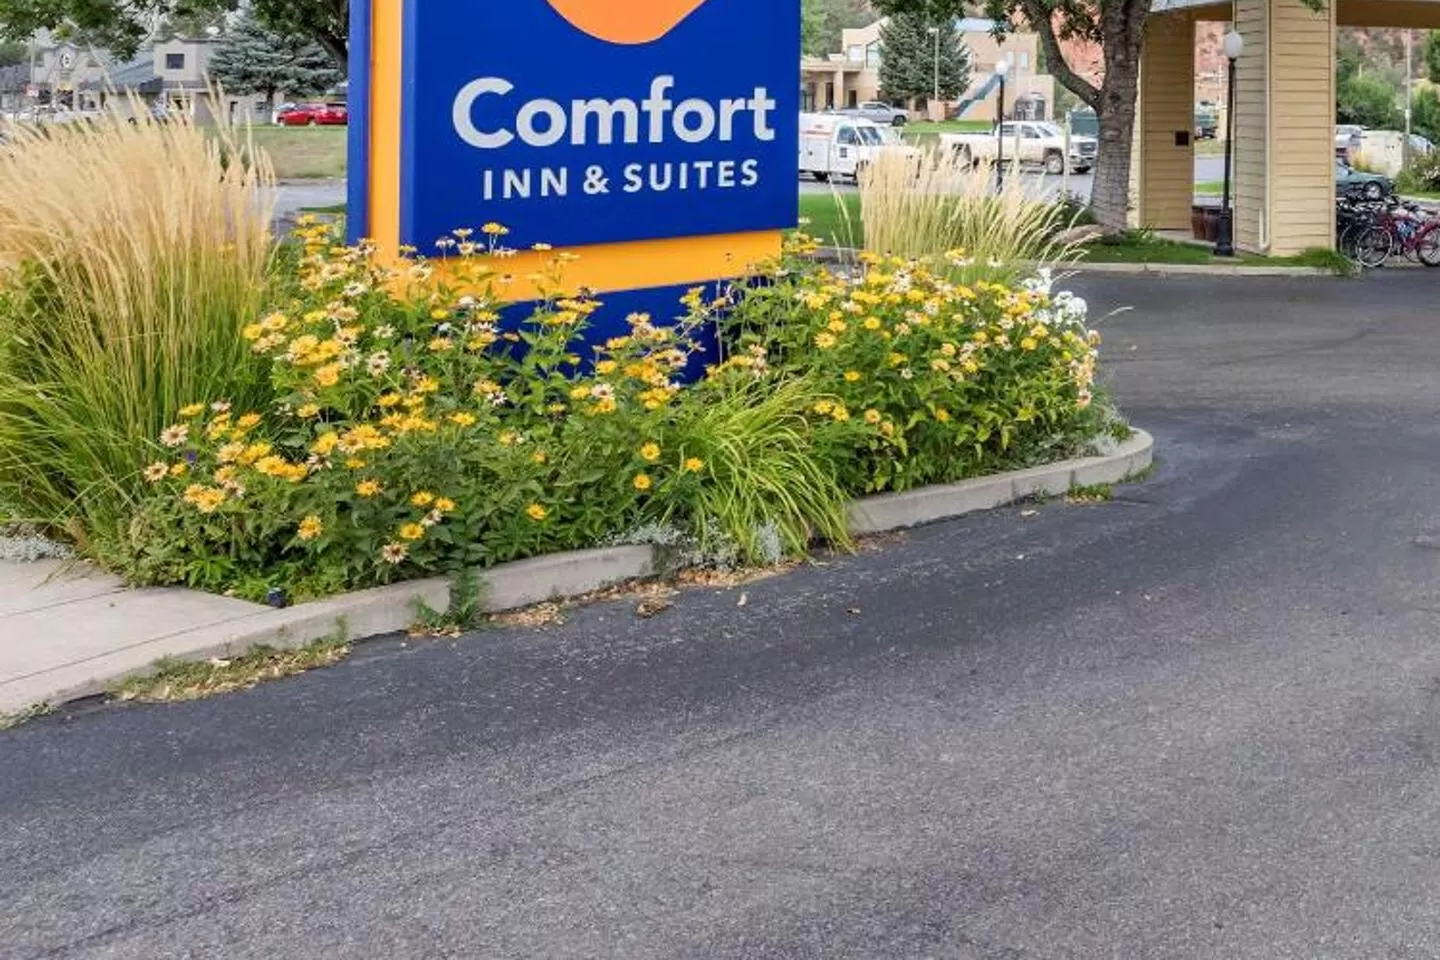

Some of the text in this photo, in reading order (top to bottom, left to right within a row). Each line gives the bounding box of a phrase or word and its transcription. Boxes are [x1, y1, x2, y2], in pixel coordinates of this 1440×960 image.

[452, 75, 776, 149] Comfort
[483, 158, 758, 200] INN & SUITES
